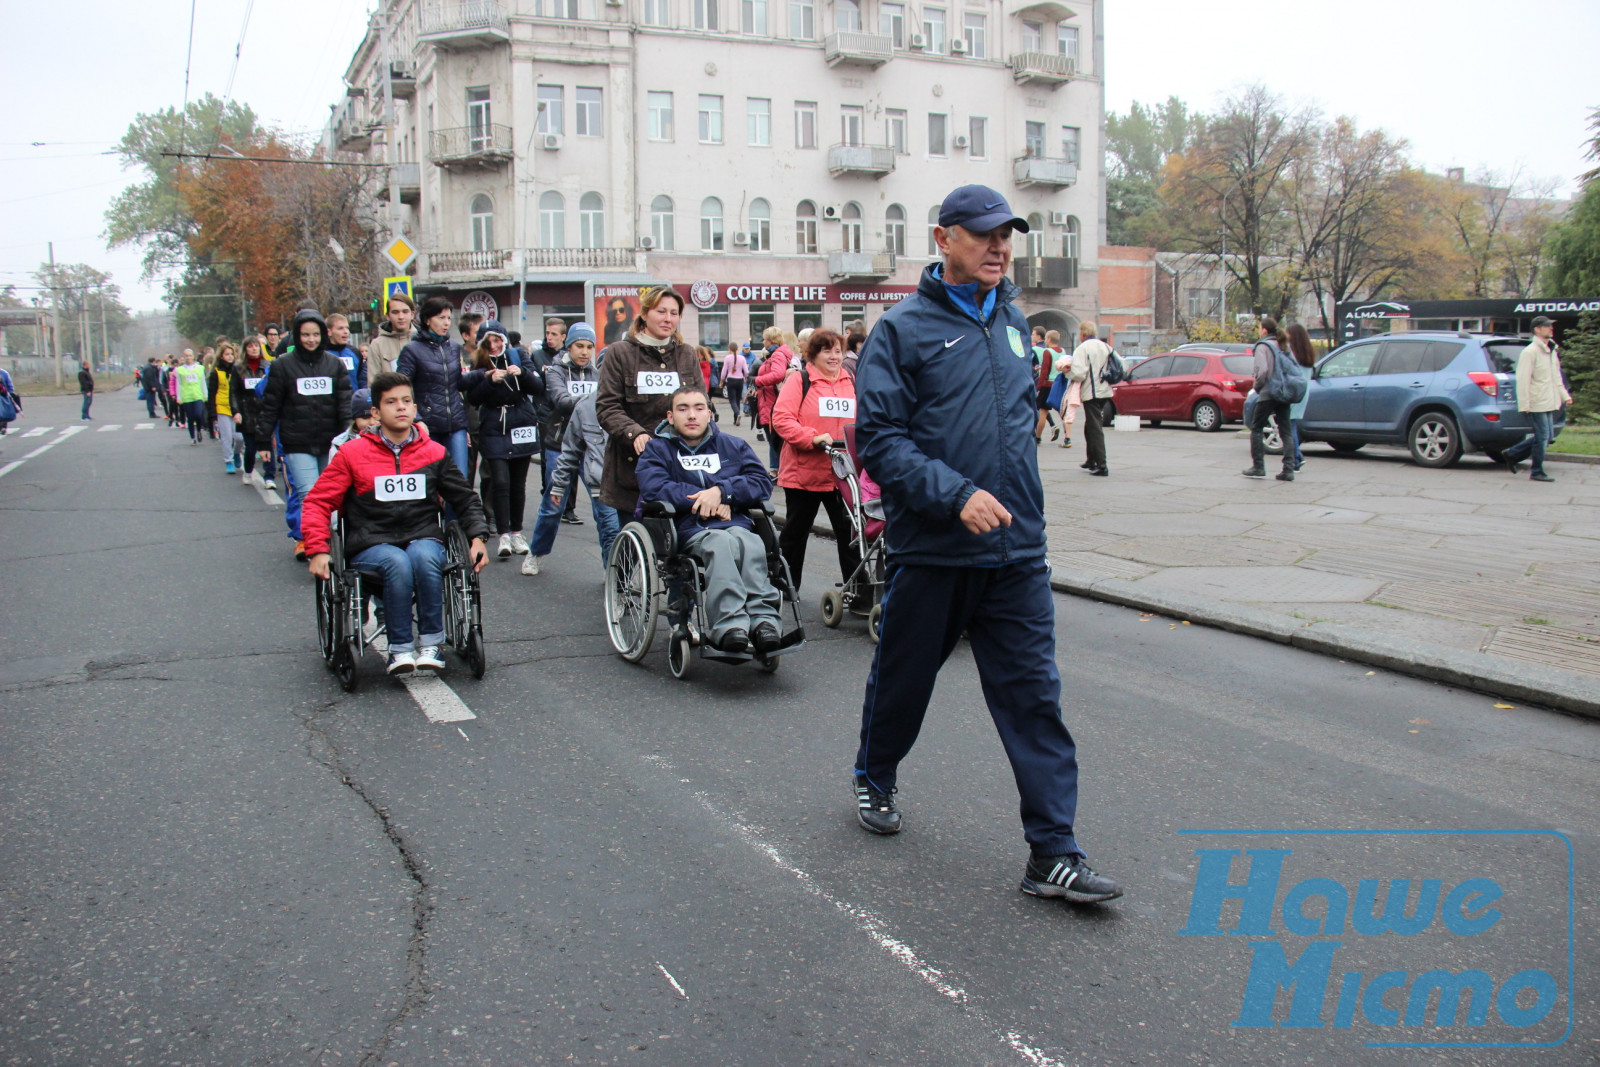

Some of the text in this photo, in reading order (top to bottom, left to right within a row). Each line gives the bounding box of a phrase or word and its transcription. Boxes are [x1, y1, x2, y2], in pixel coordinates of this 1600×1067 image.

[606, 287, 639, 297] ШИННИК
[726, 285, 790, 301] COFFEE
[794, 286, 827, 301] LIFE
[840, 292, 867, 300] COFFEE
[868, 292, 879, 300] AS
[1345, 311, 1386, 319] ALMAZ
[303, 379, 327, 390] 639
[645, 374, 673, 387] 632
[571, 383, 593, 394] 617
[826, 399, 849, 412] 619
[513, 428, 533, 439] 623
[384, 477, 417, 494] 618
